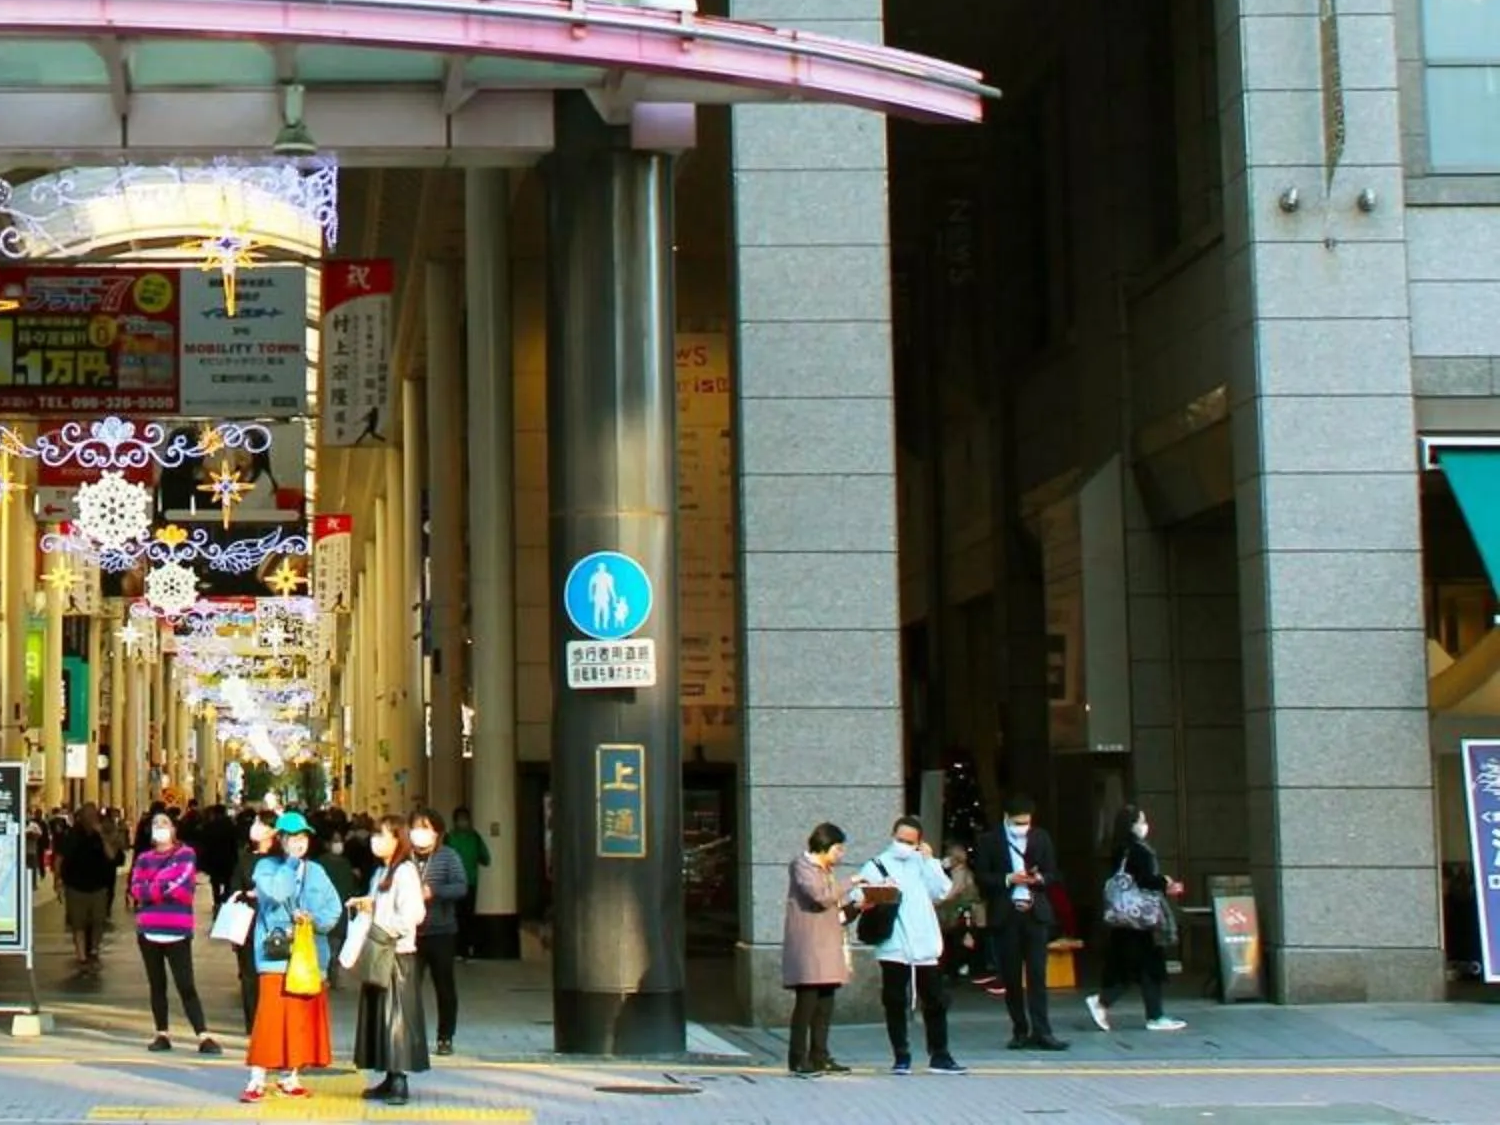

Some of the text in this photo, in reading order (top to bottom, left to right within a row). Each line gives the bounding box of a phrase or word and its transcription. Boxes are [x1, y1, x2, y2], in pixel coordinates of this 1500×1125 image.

[184, 342, 301, 355] MOBILITY TOWN
[601, 760, 640, 841] 上通
